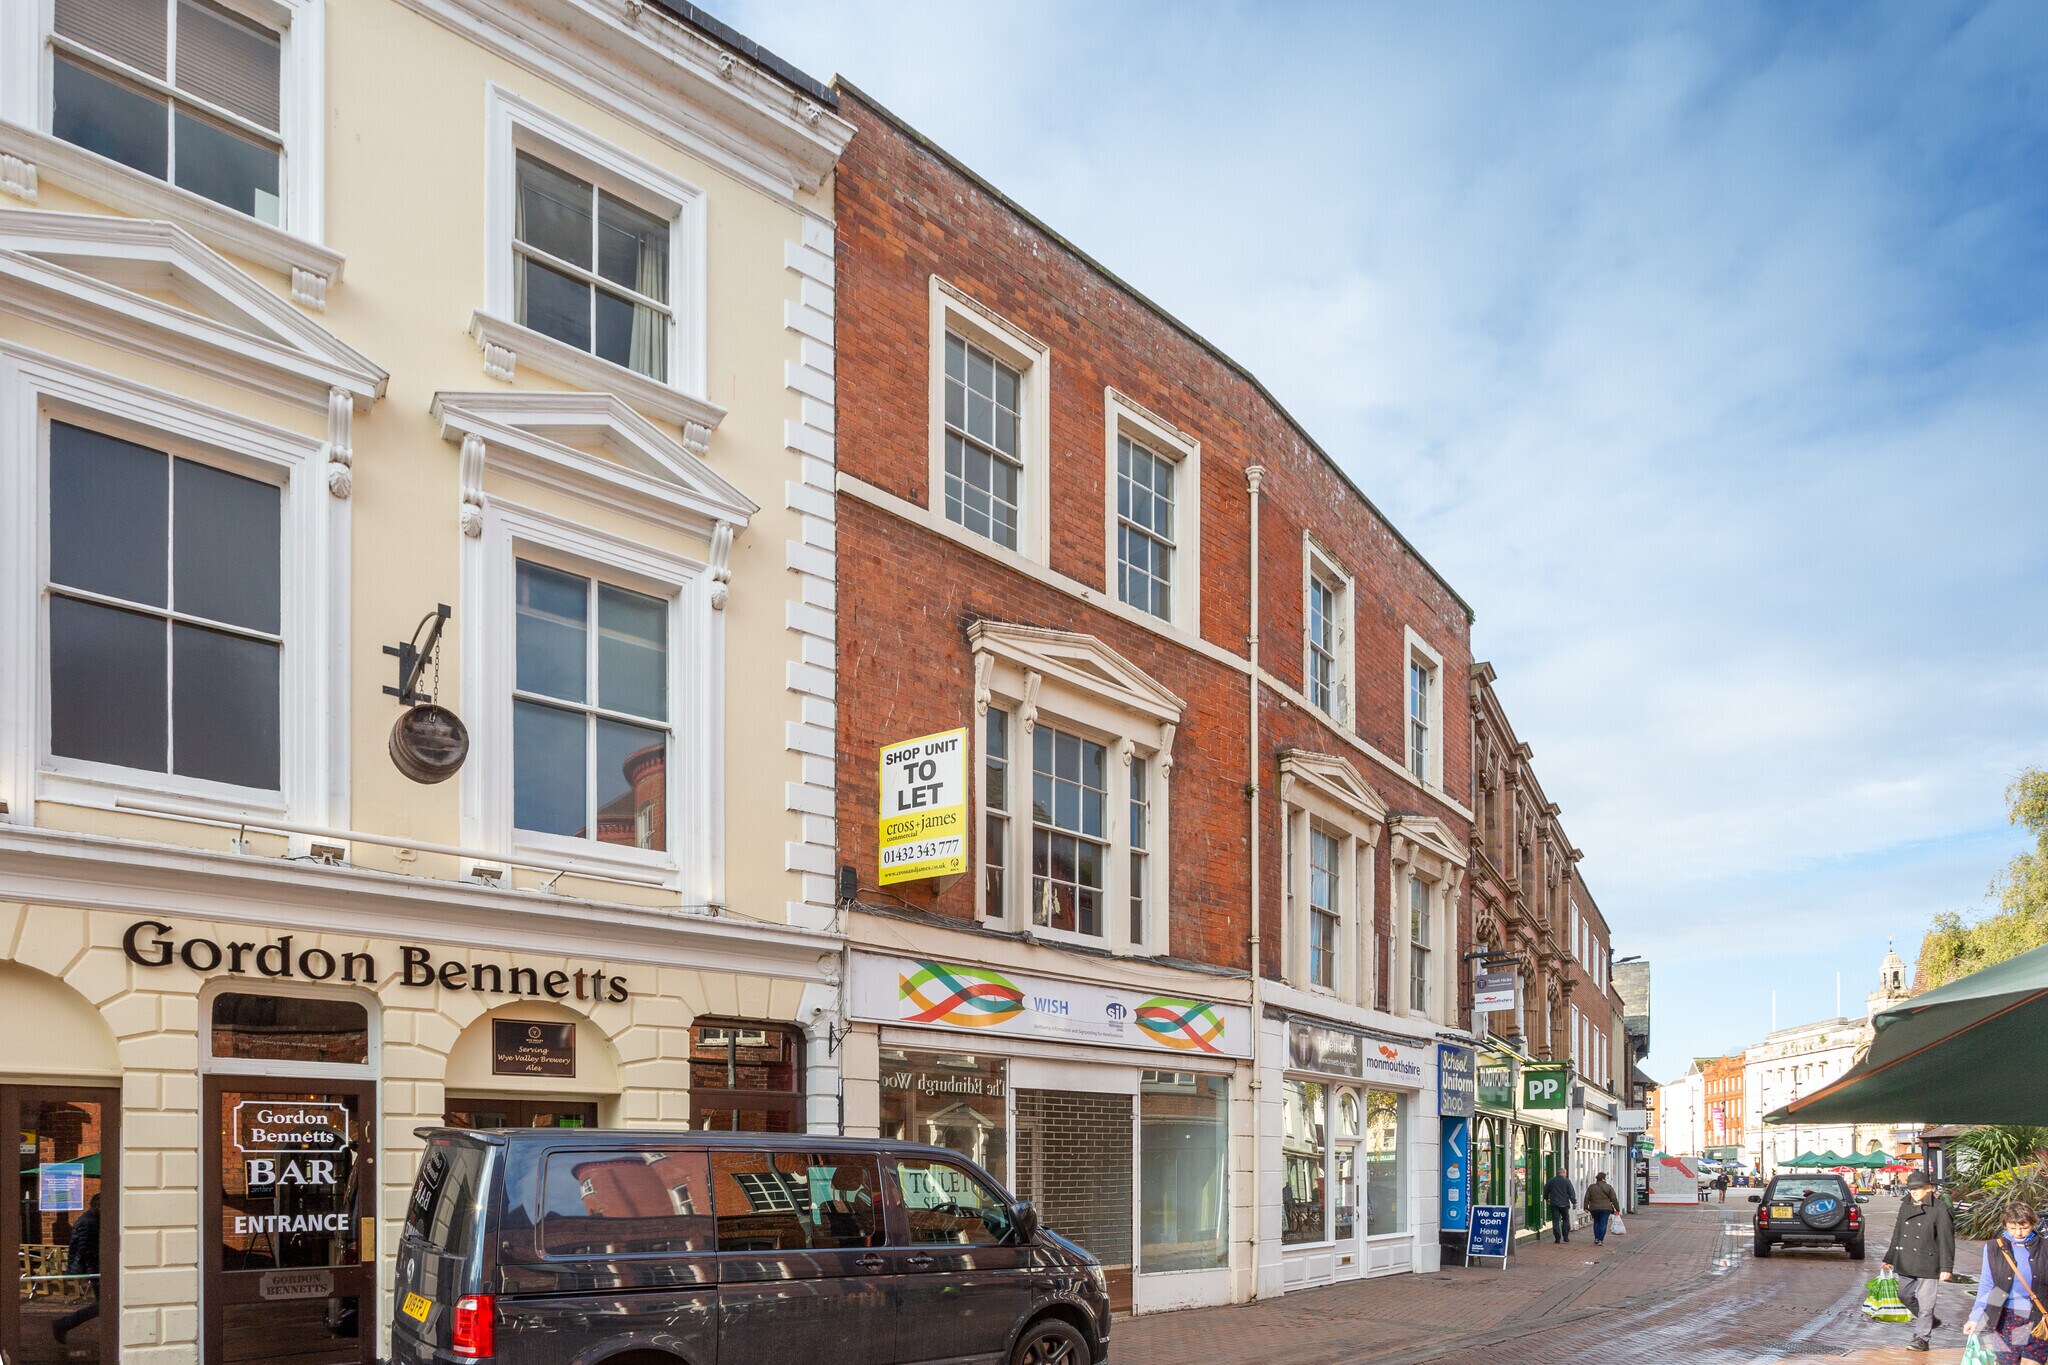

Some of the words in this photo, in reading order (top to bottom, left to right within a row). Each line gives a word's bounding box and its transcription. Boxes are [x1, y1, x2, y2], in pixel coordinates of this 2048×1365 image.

[885, 747, 920, 766] SHOP
[925, 738, 958, 757] UNIT
[903, 759, 937, 785] TO
[898, 782, 944, 812] LET
[886, 830, 918, 843] commercial
[884, 846, 914, 864] 01432
[916, 843, 936, 859] 343
[938, 839, 960, 856] 777
[122, 920, 377, 984] Gordon
[399, 945, 629, 1003] Bennetts
[1033, 996, 1069, 1015] WISH
[1107, 1005, 1124, 1020] sil
[518, 1046, 549, 1055] Serving
[497, 1053, 515, 1062] Wye
[514, 1054, 540, 1064] Valley
[540, 1055, 571, 1066] Brewery
[525, 1063, 543, 1071] Ales
[1366, 1057, 1420, 1075] monmouthshire
[1442, 1050, 1468, 1072] School
[1442, 1072, 1474, 1093] Uniform
[1442, 1091, 1463, 1114] Shop
[256, 1109, 328, 1125] Gordon
[251, 1128, 334, 1143] Bennetts
[247, 1159, 337, 1185] BAR
[1477, 1209, 1490, 1218] We
[235, 1213, 349, 1234] ENTRANCE
[1480, 1218, 1502, 1226] open
[1473, 1235, 1482, 1243] to
[1485, 1236, 1504, 1245] help
[1480, 1228, 1499, 1236] Here
[272, 1274, 322, 1285] GORDON
[266, 1283, 328, 1296] BENNETTS
